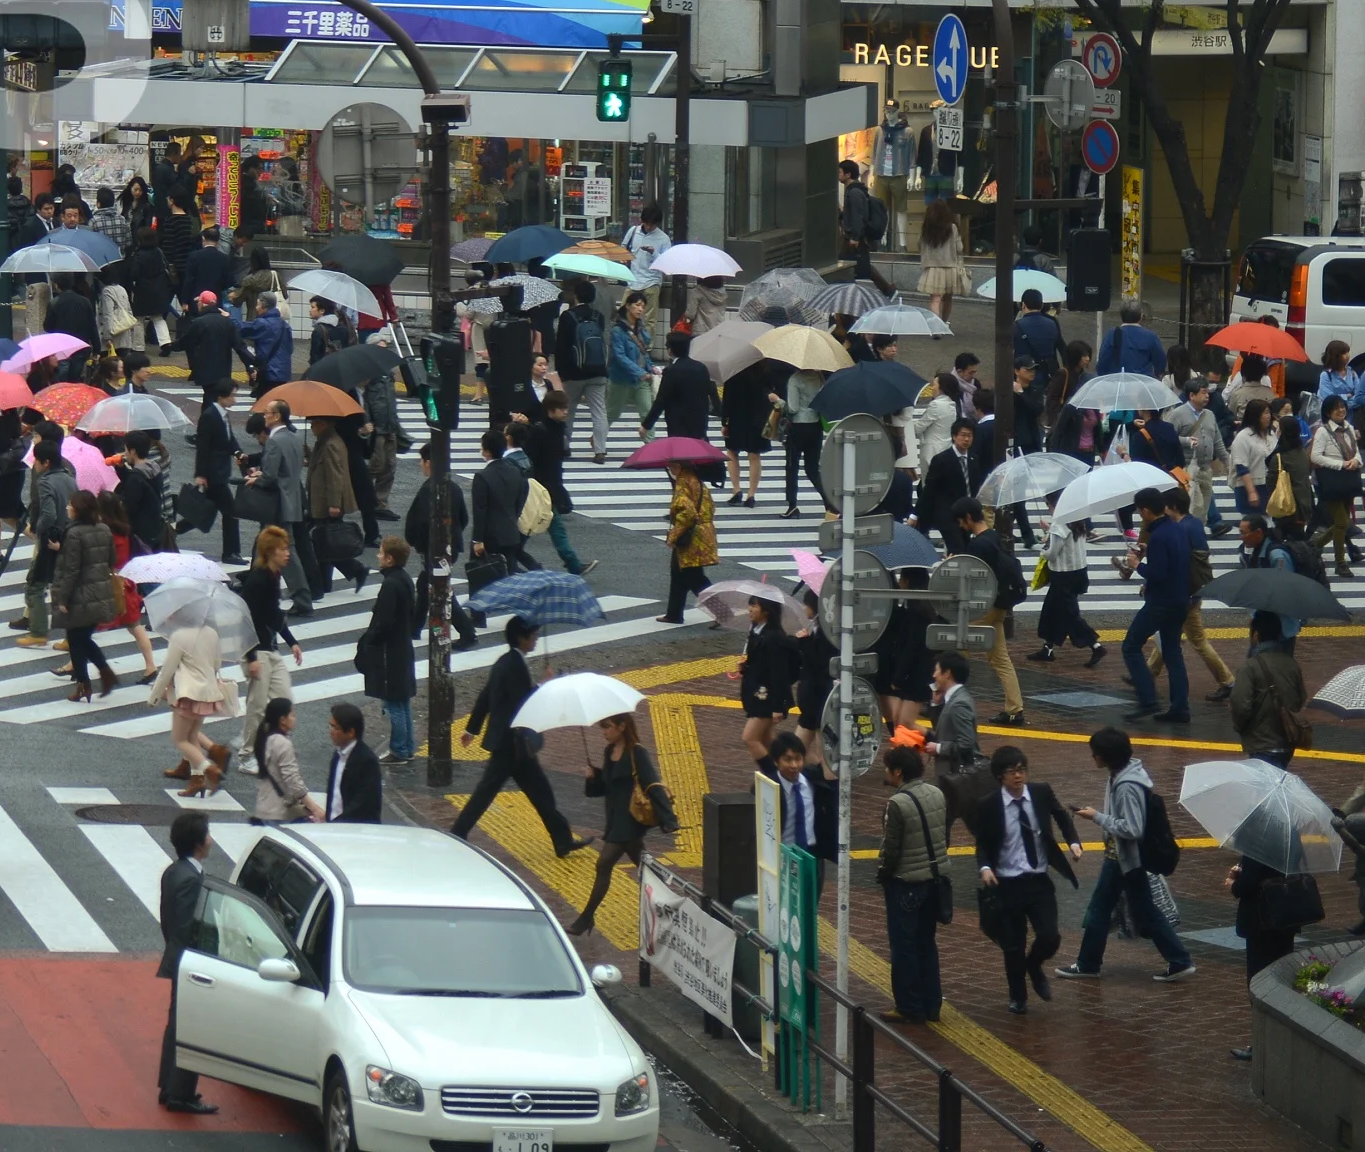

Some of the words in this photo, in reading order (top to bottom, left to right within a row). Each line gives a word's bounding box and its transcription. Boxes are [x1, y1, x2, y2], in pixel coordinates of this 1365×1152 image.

[285, 9, 371, 37] 三千里薬品
[854, 42, 930, 67] RAGE
